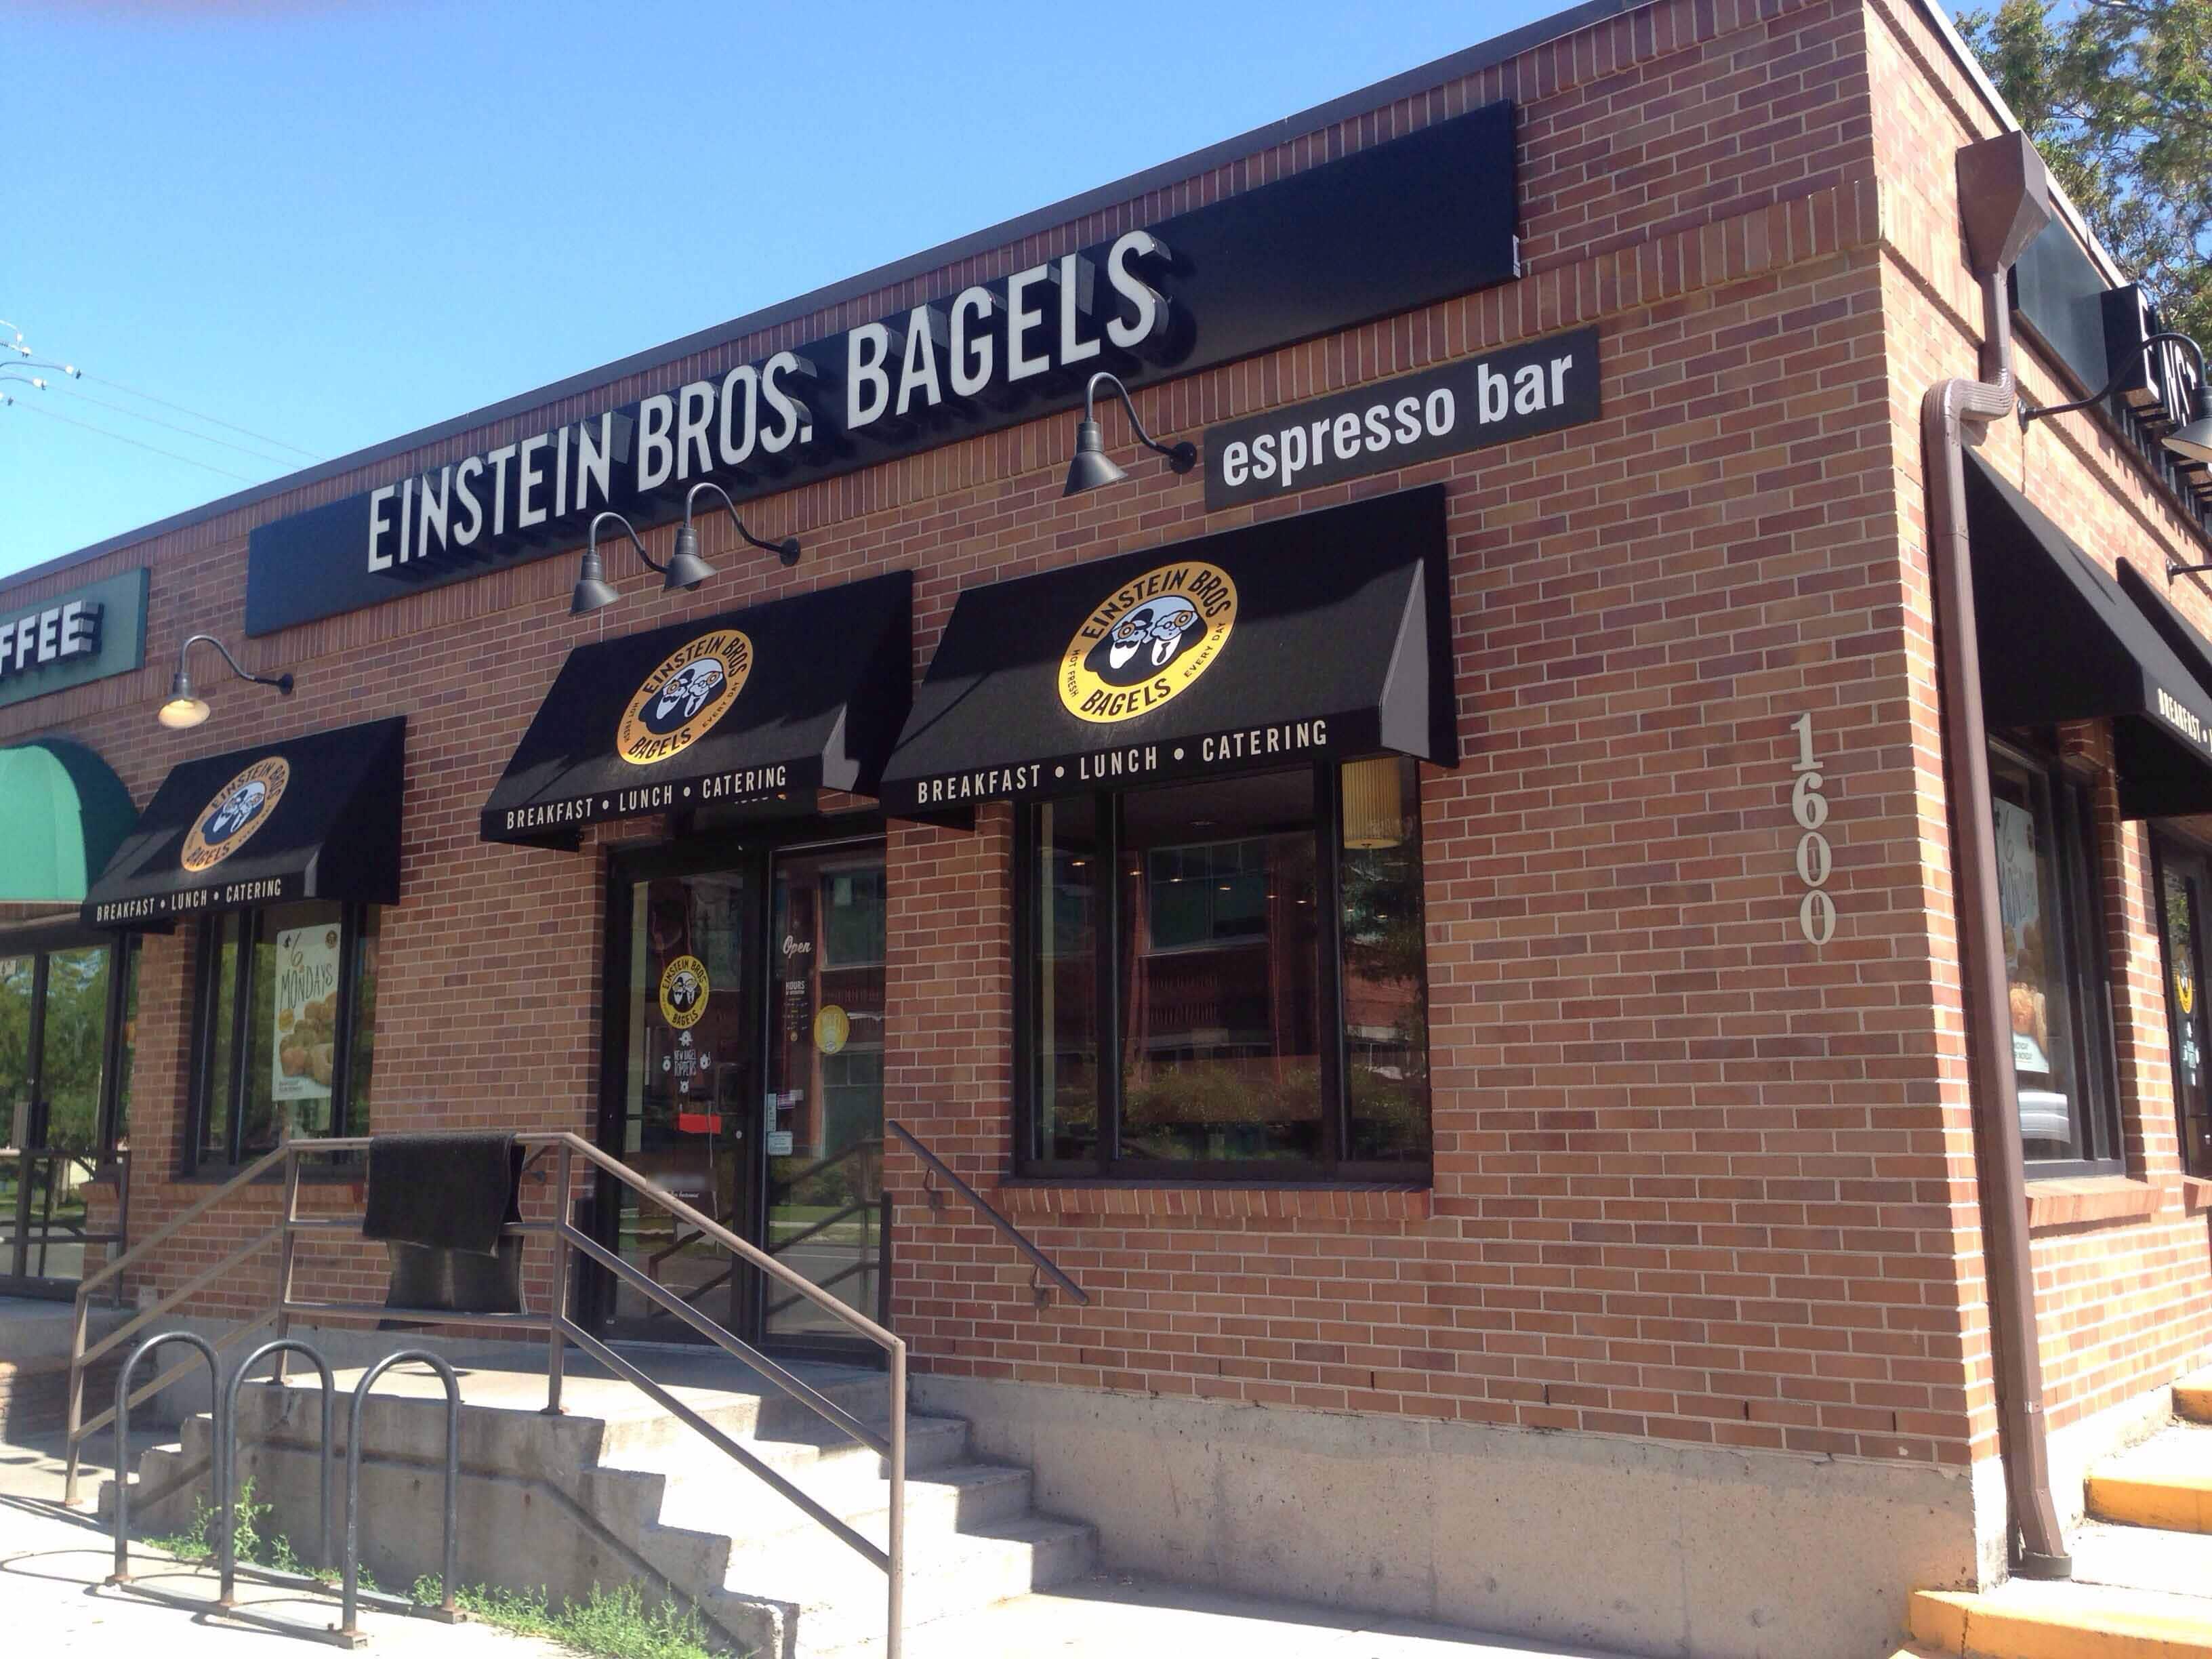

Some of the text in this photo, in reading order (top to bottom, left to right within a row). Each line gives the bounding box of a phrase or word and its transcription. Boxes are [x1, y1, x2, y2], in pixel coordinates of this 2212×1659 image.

[368, 230, 1156, 573] EINSTEIN BROS. BAGELS
[1223, 354, 1572, 487] espresso bar
[1082, 569, 1231, 639] EINSTEIN BROS
[643, 635, 747, 694] EINSTEIN BROS
[1067, 649, 1080, 697] HOT FRESH
[1185, 623, 1226, 678] EVERY DAY
[702, 681, 740, 727] EVERY DAY
[1080, 678, 1171, 716] BAGELS
[2158, 688, 2201, 743] BREAKFAST
[628, 727, 691, 759] BAGELS
[918, 720, 1327, 804] BREAKFAST LUNCH CATERING
[211, 762, 276, 808] EINSTEIN
[507, 766, 786, 830] BREAKFAST LUNCH CATERING
[1790, 712, 1836, 945] 1600
[186, 843, 230, 867] BAGELS
[97, 878, 281, 922] BREAKFAST LUNCH CATERING
[783, 935, 812, 959] Open
[281, 962, 333, 1011] MONDAYS
[662, 959, 706, 989] EINSTEIN BROS
[785, 981, 805, 990] HOURS
[672, 1010, 699, 1026] BAGELS
